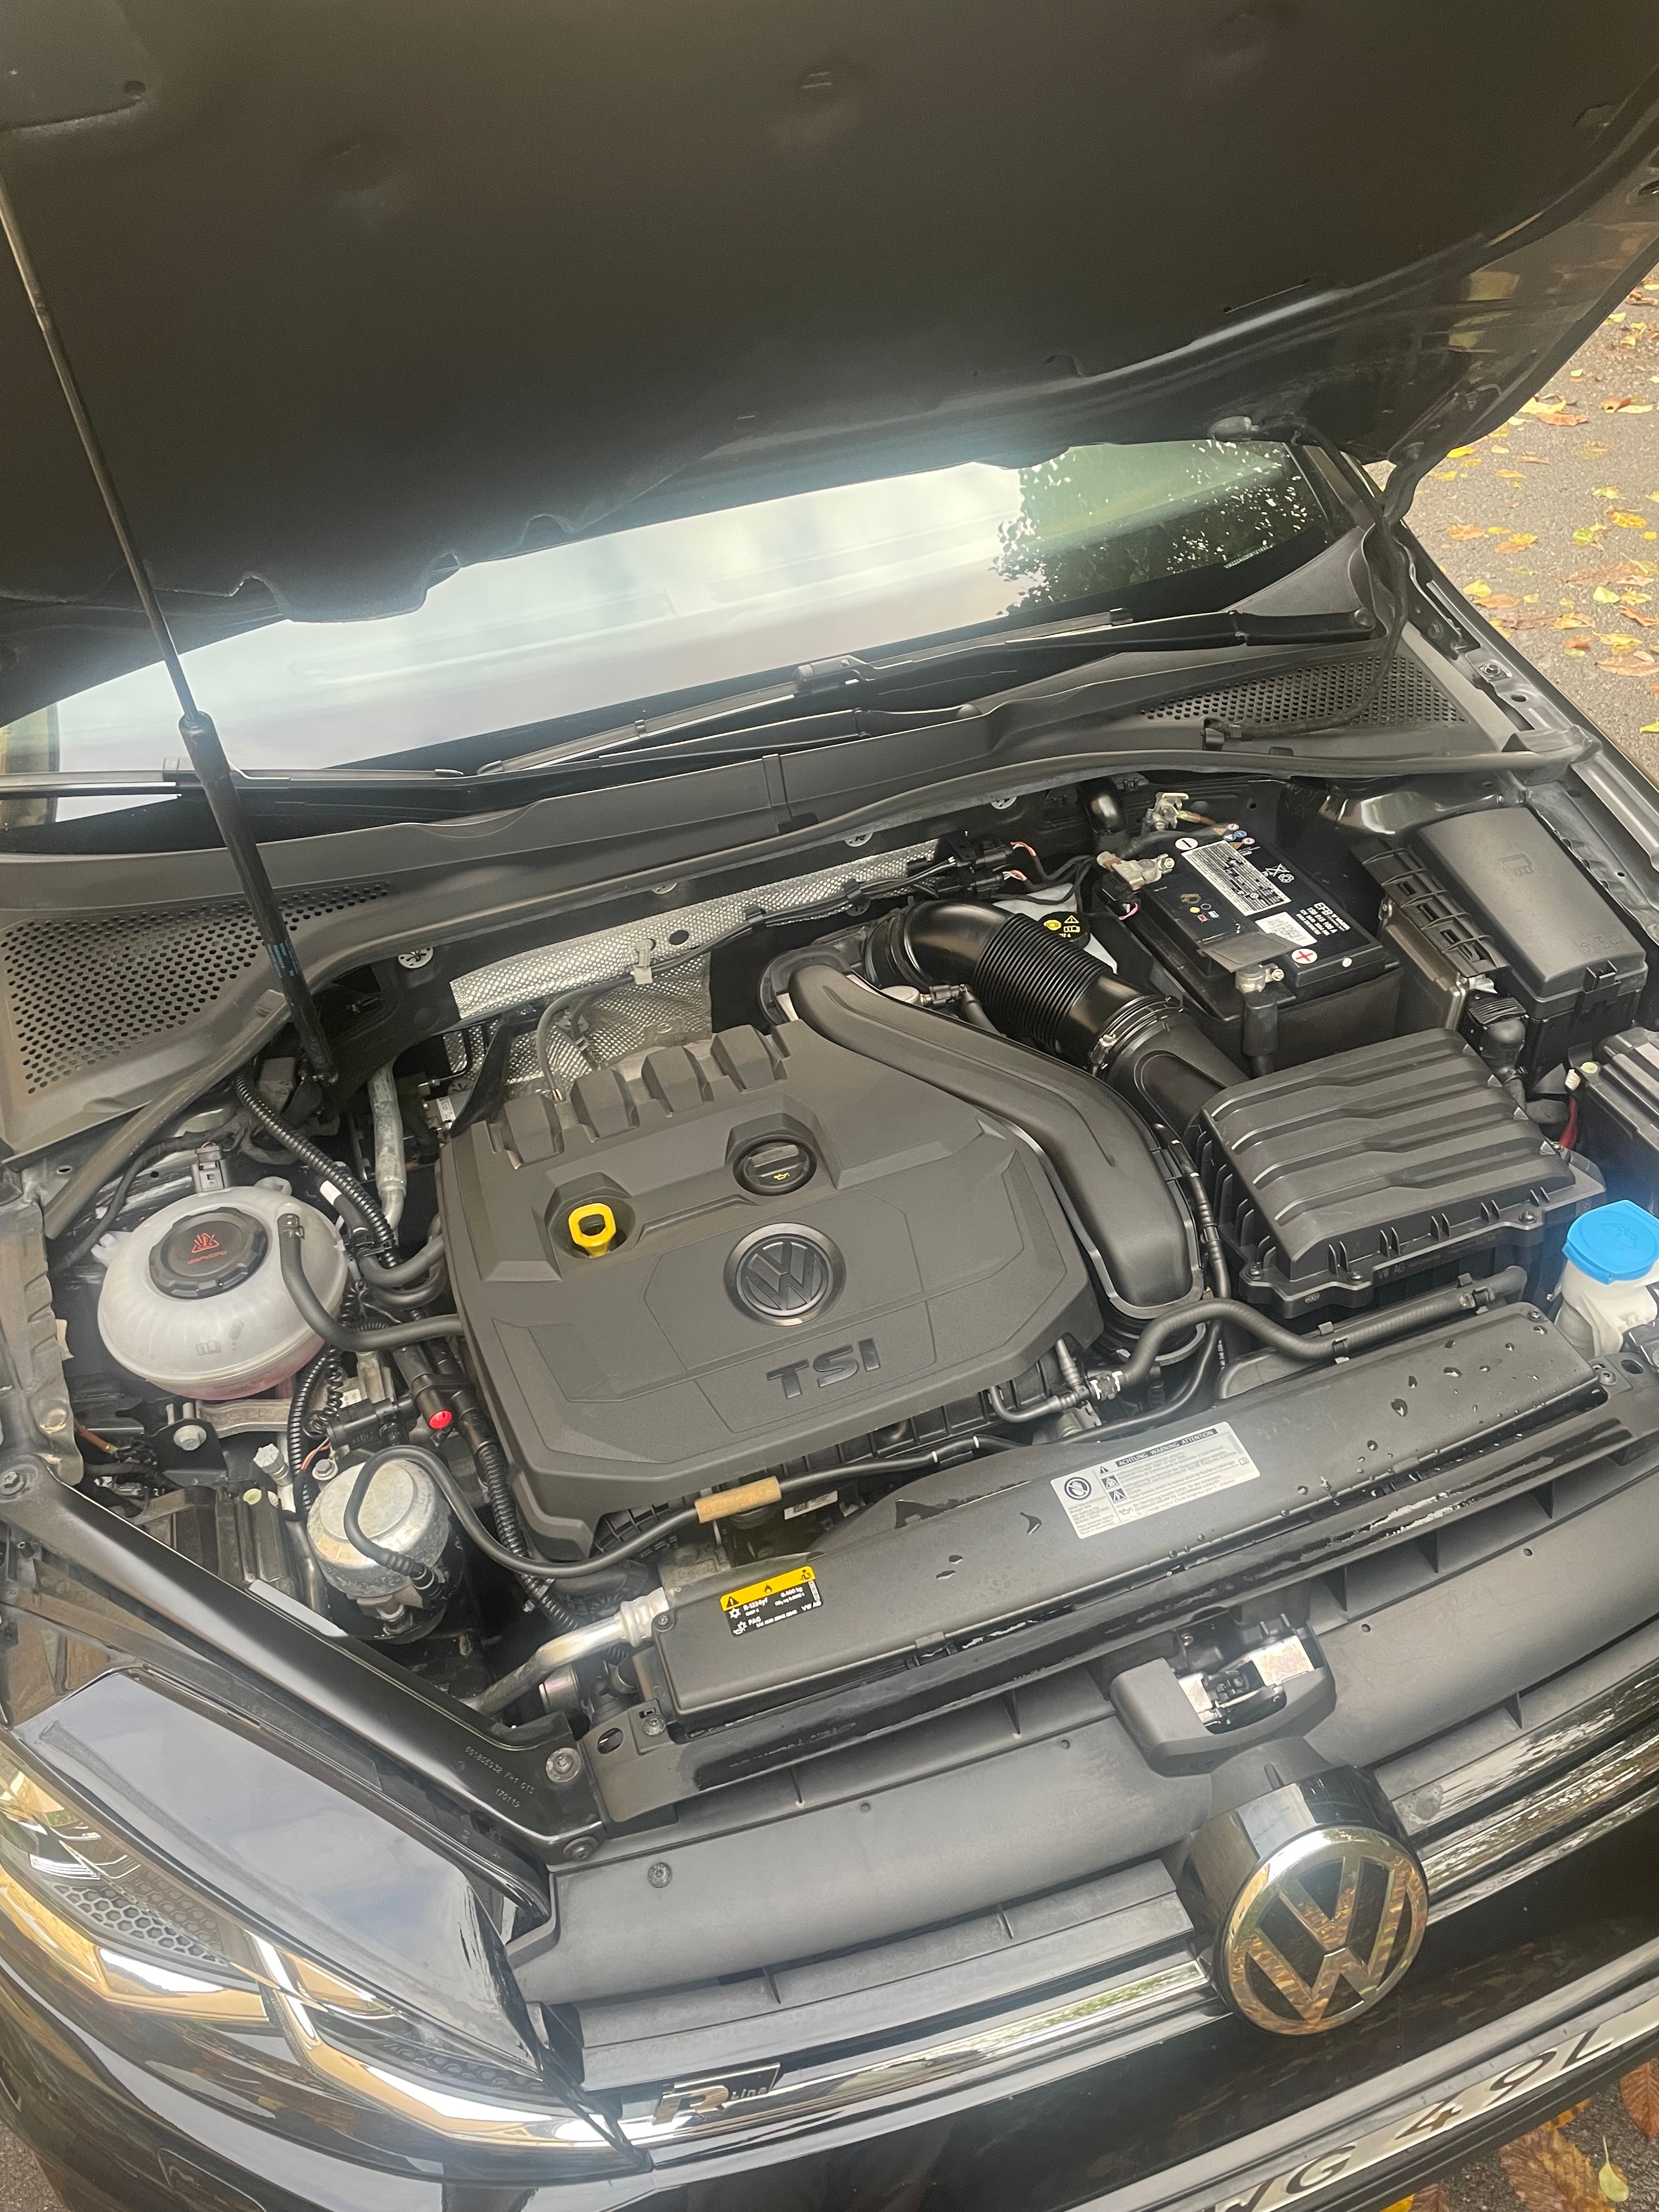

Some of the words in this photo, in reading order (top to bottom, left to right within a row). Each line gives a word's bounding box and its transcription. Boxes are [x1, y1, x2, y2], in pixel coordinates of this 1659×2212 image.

[1313, 902, 1333, 916] EFB
[737, 1236, 831, 1315] VW
[767, 1338, 881, 1400] TSI
[1118, 1452, 1148, 1466] ACHTUNG
[1149, 1442, 1180, 1455] WARNING
[1181, 1430, 1214, 1445] ATTENTION
[748, 1616, 761, 1626] PAG
[801, 1603, 812, 1611] VW
[1241, 1850, 1412, 2027] VW
[652, 2084, 729, 2126] R
